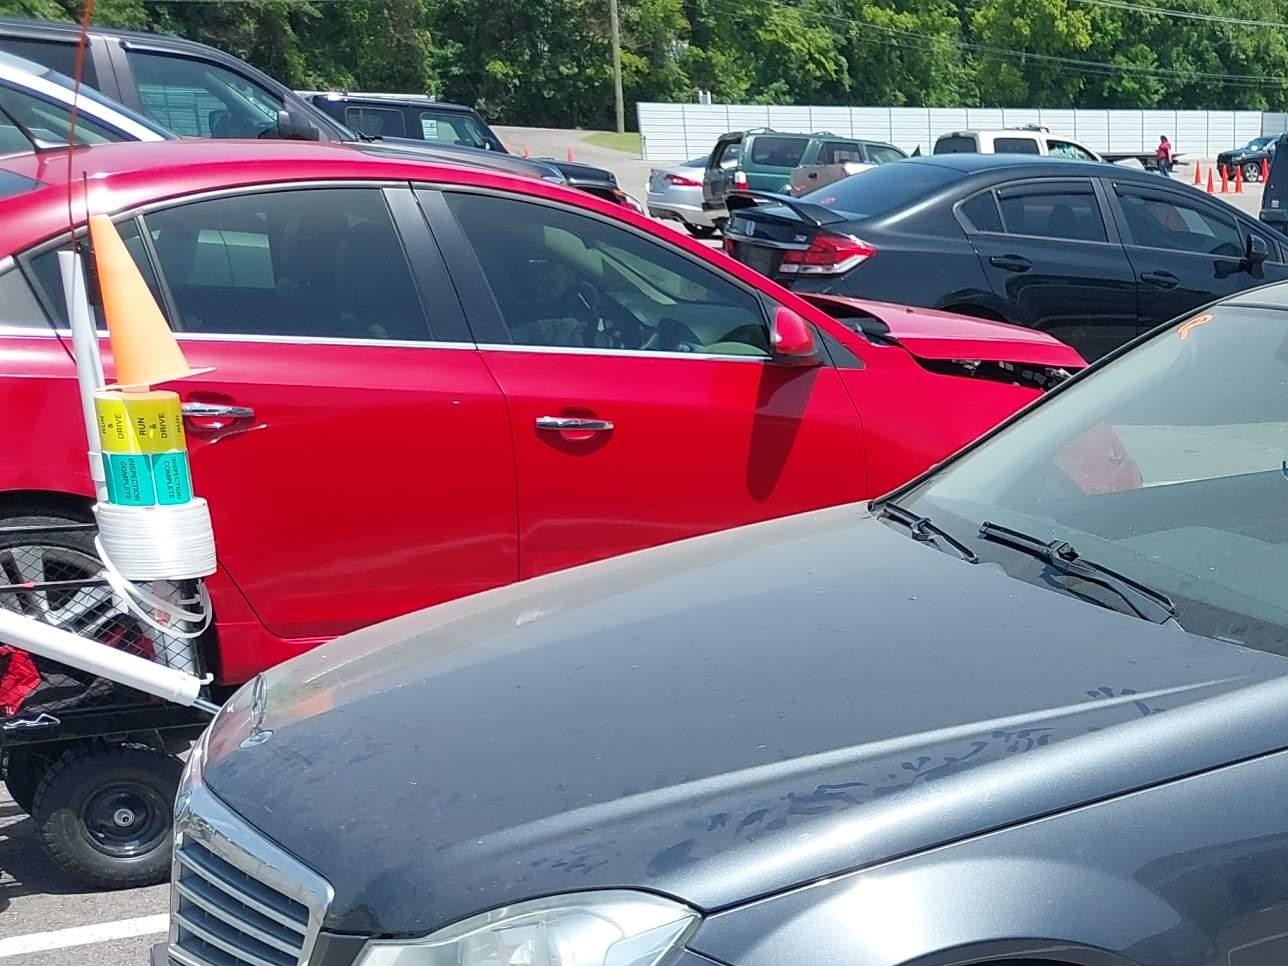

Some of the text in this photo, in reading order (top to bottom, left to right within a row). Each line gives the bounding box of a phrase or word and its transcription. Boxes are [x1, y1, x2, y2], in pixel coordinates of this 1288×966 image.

[115, 413, 125, 440] DRIVE
[137, 417, 147, 436] RUN
[158, 412, 169, 439] DRIVE
[120, 461, 132, 500] COMPLETE
[127, 457, 142, 502] INSPECTION
[163, 460, 175, 499] COMPLETE
[171, 456, 183, 499] INSPECTION
